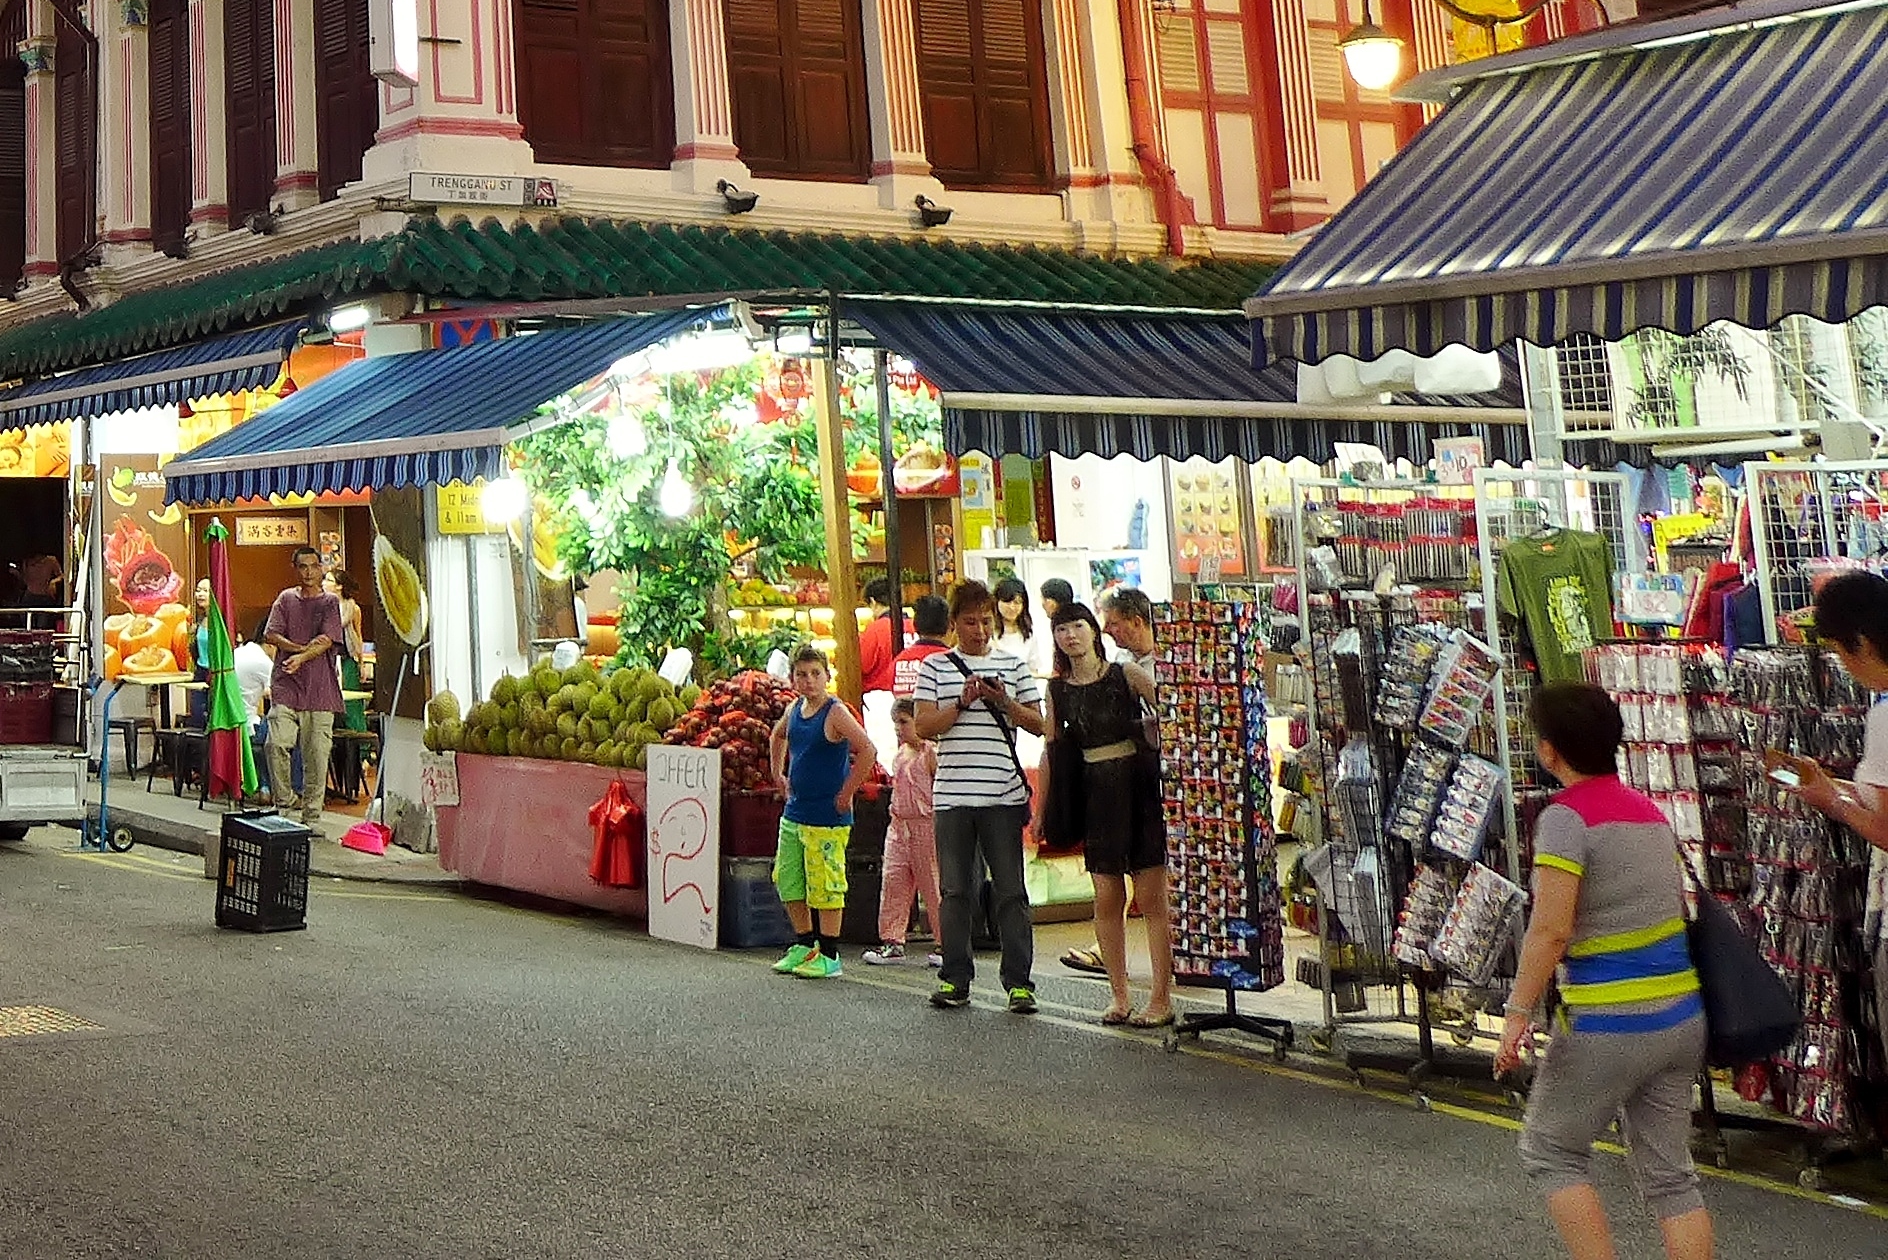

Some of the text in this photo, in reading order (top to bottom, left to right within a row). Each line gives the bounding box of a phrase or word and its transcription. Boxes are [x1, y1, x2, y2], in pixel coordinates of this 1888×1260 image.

[430, 177, 513, 191] TRENGGANU ST
[457, 511, 477, 524] 11am
